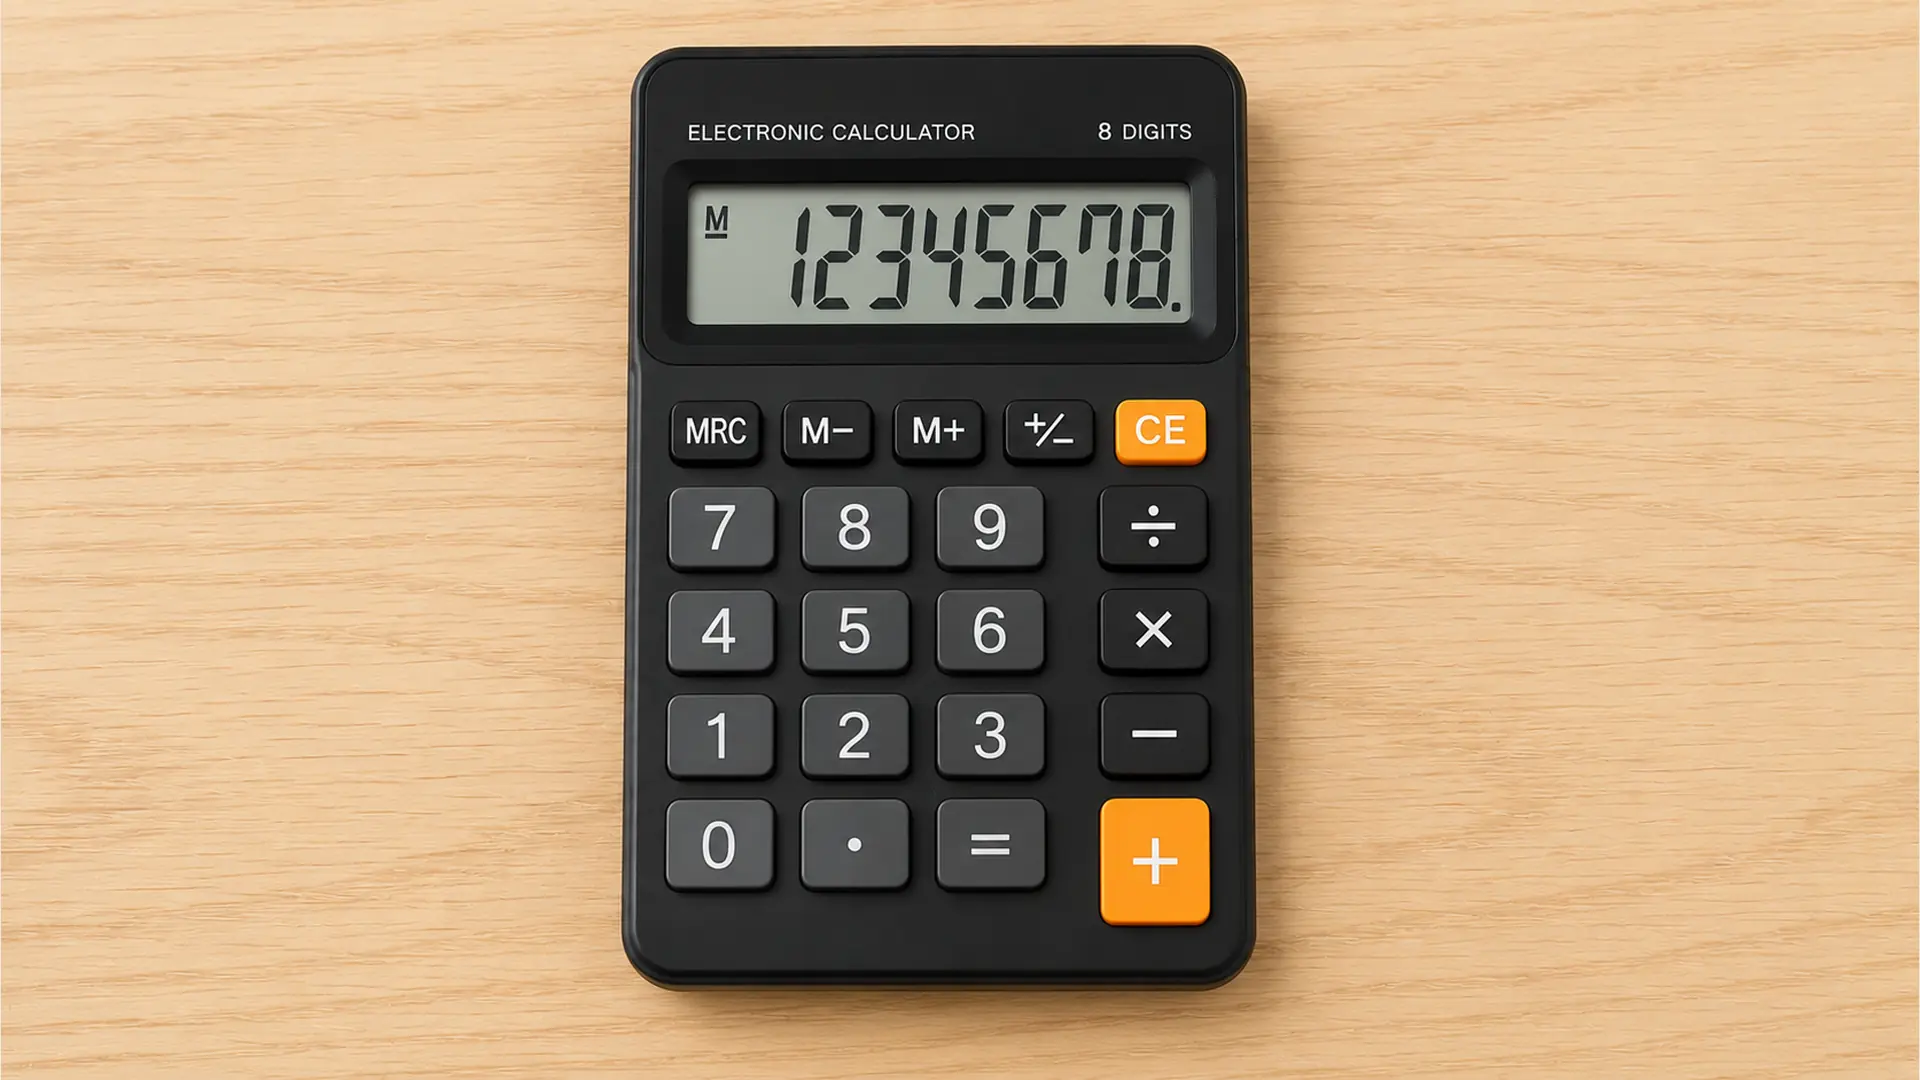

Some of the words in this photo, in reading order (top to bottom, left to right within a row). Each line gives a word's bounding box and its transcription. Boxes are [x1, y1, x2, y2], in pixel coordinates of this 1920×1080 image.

[688, 124, 824, 141] ELECTRONIC
[832, 123, 975, 141] CALCULATOR
[1098, 122, 1112, 141] 8
[1123, 123, 1192, 140] DIGITS
[704, 205, 729, 233] M
[790, 203, 1182, 313] 12345678.
[686, 417, 747, 445] MRC
[913, 416, 965, 444] M+
[1135, 414, 1186, 445] CE
[704, 504, 736, 551] 7
[838, 503, 871, 551] 8
[973, 503, 1006, 551] 9
[701, 607, 736, 654] 4
[838, 607, 870, 654] 5
[973, 606, 1006, 654] 6
[707, 712, 726, 759] 1
[838, 711, 870, 759] 2
[974, 711, 1007, 759] 3
[702, 820, 736, 870] 0
[970, 834, 1010, 855] =
[1132, 837, 1178, 885] +
